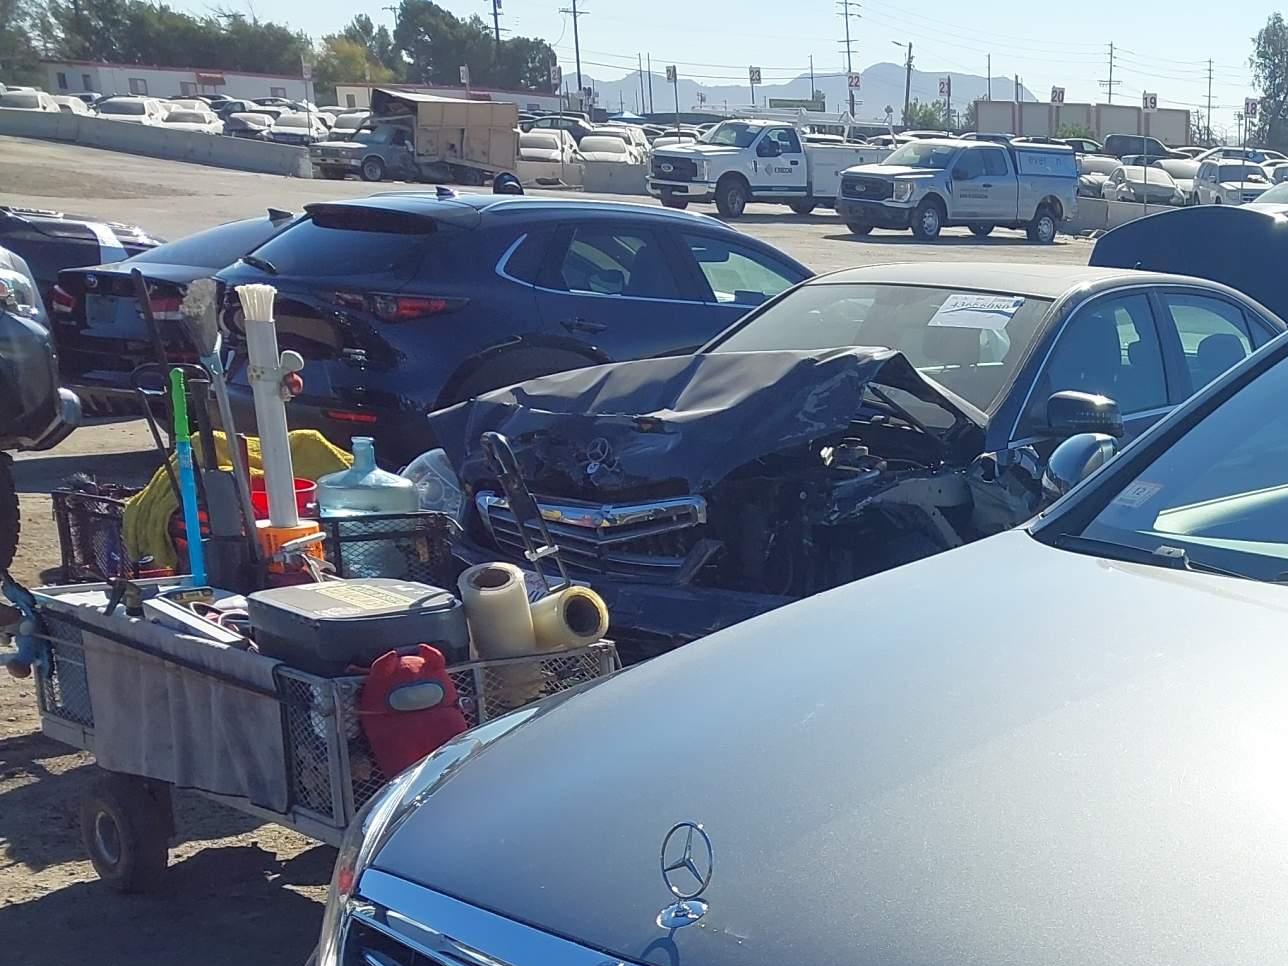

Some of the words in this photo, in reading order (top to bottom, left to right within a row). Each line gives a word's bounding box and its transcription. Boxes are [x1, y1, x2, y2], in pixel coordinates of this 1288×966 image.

[749, 70, 761, 82] 23
[847, 75, 860, 88] 22
[1050, 90, 1064, 103] 20
[1143, 96, 1156, 109] 19
[1245, 102, 1257, 115] 18
